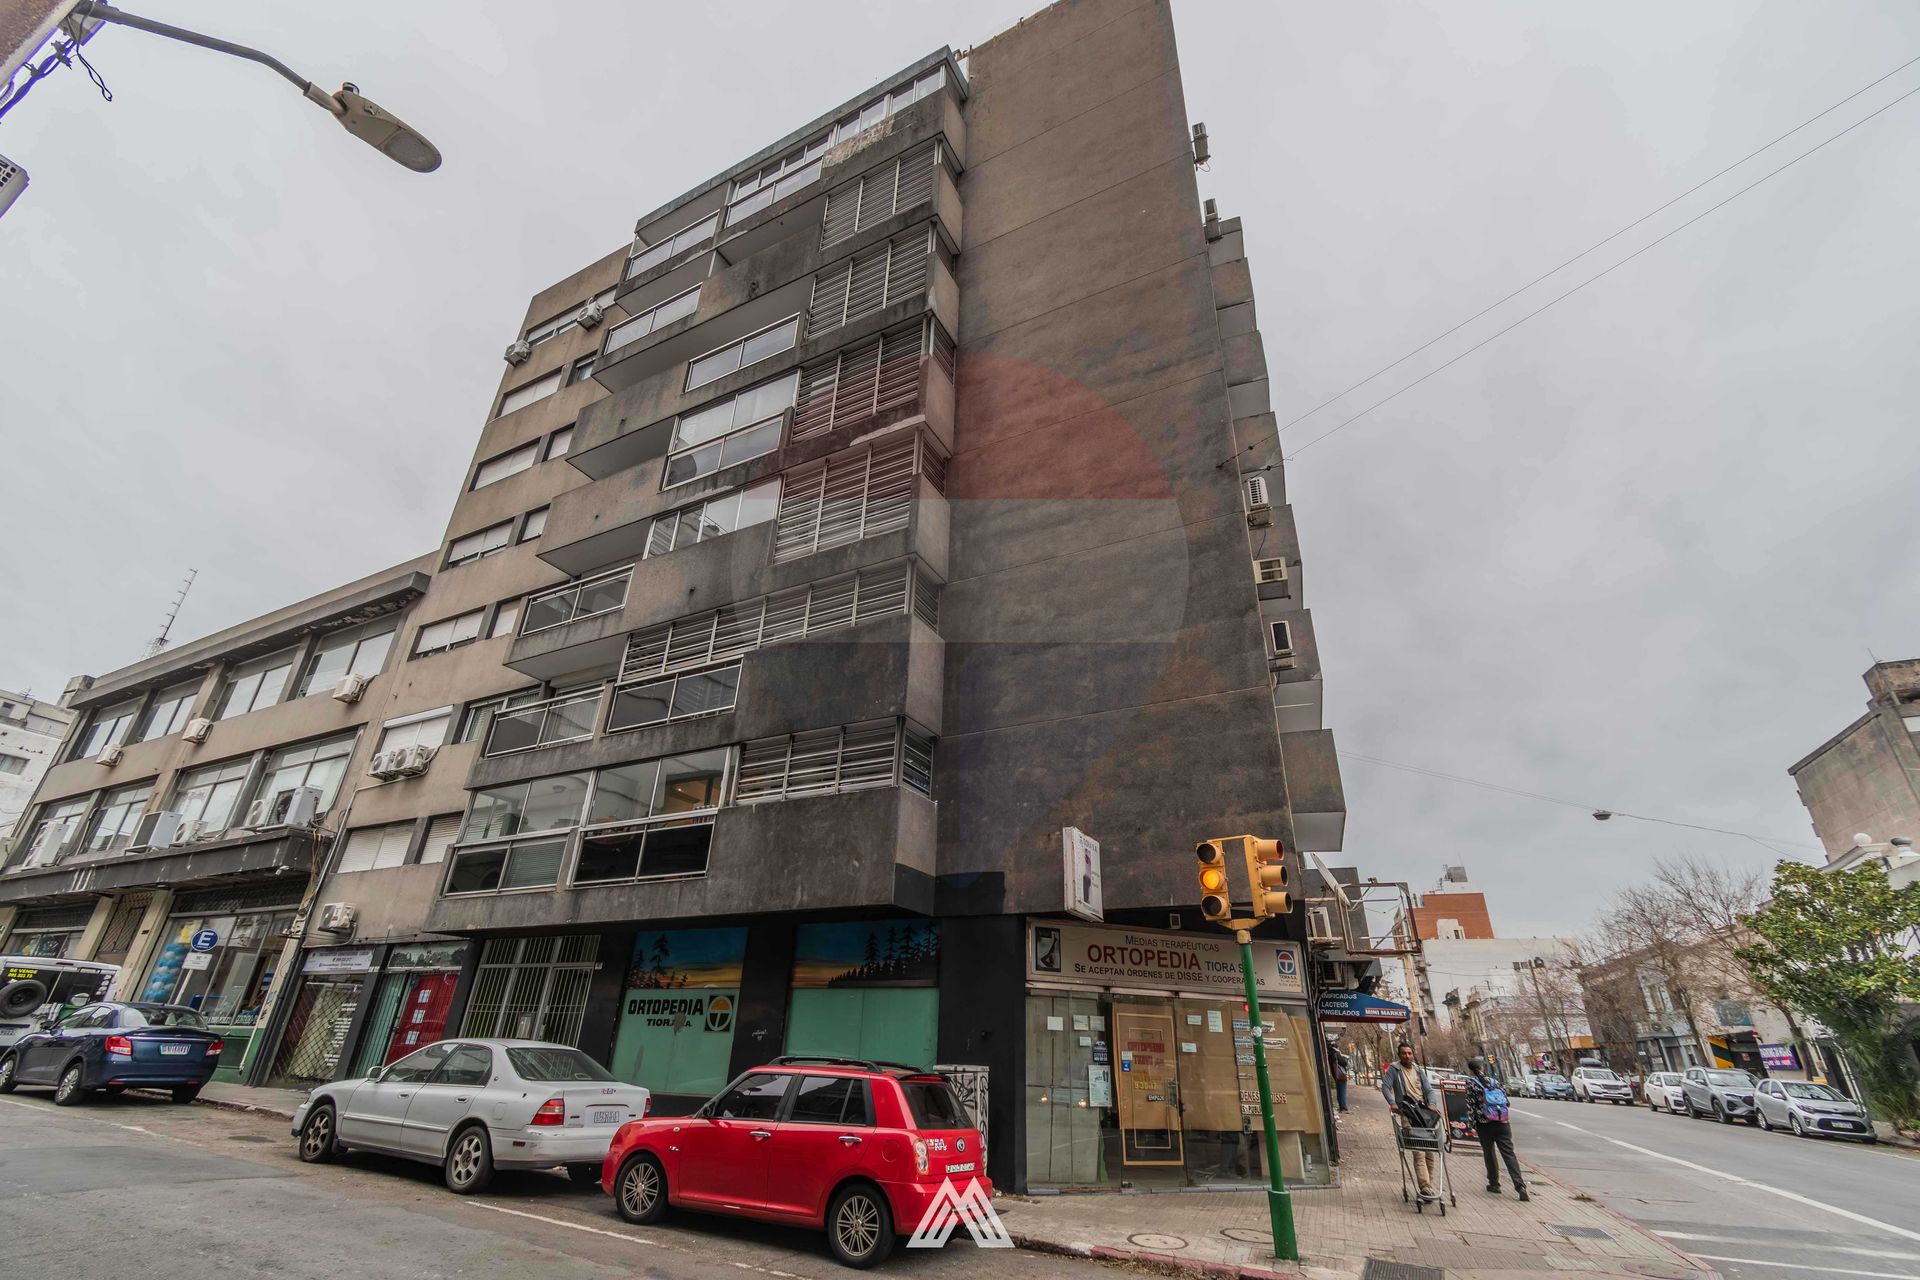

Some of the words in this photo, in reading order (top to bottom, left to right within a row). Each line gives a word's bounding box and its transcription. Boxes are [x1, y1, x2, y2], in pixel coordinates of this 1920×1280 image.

[197, 932, 214, 946] E
[1125, 935, 1158, 947] MEDIAS
[1160, 939, 1220, 952] TERAPÉUTICAS
[1087, 944, 1201, 971] ORTOPEDIA
[1205, 960, 1237, 973] TIORA
[1074, 962, 1086, 973] SE
[1088, 966, 1125, 976] ACEPTAN
[1127, 967, 1163, 980] ÓRDENES
[1165, 972, 1175, 980] DE
[1177, 971, 1203, 982] DISSE
[1205, 974, 1210, 983] Y
[1213, 975, 1265, 986] COOPERAAS
[628, 998, 704, 1016] ORTOPEDIA
[1380, 1009, 1407, 1017] MARKET
